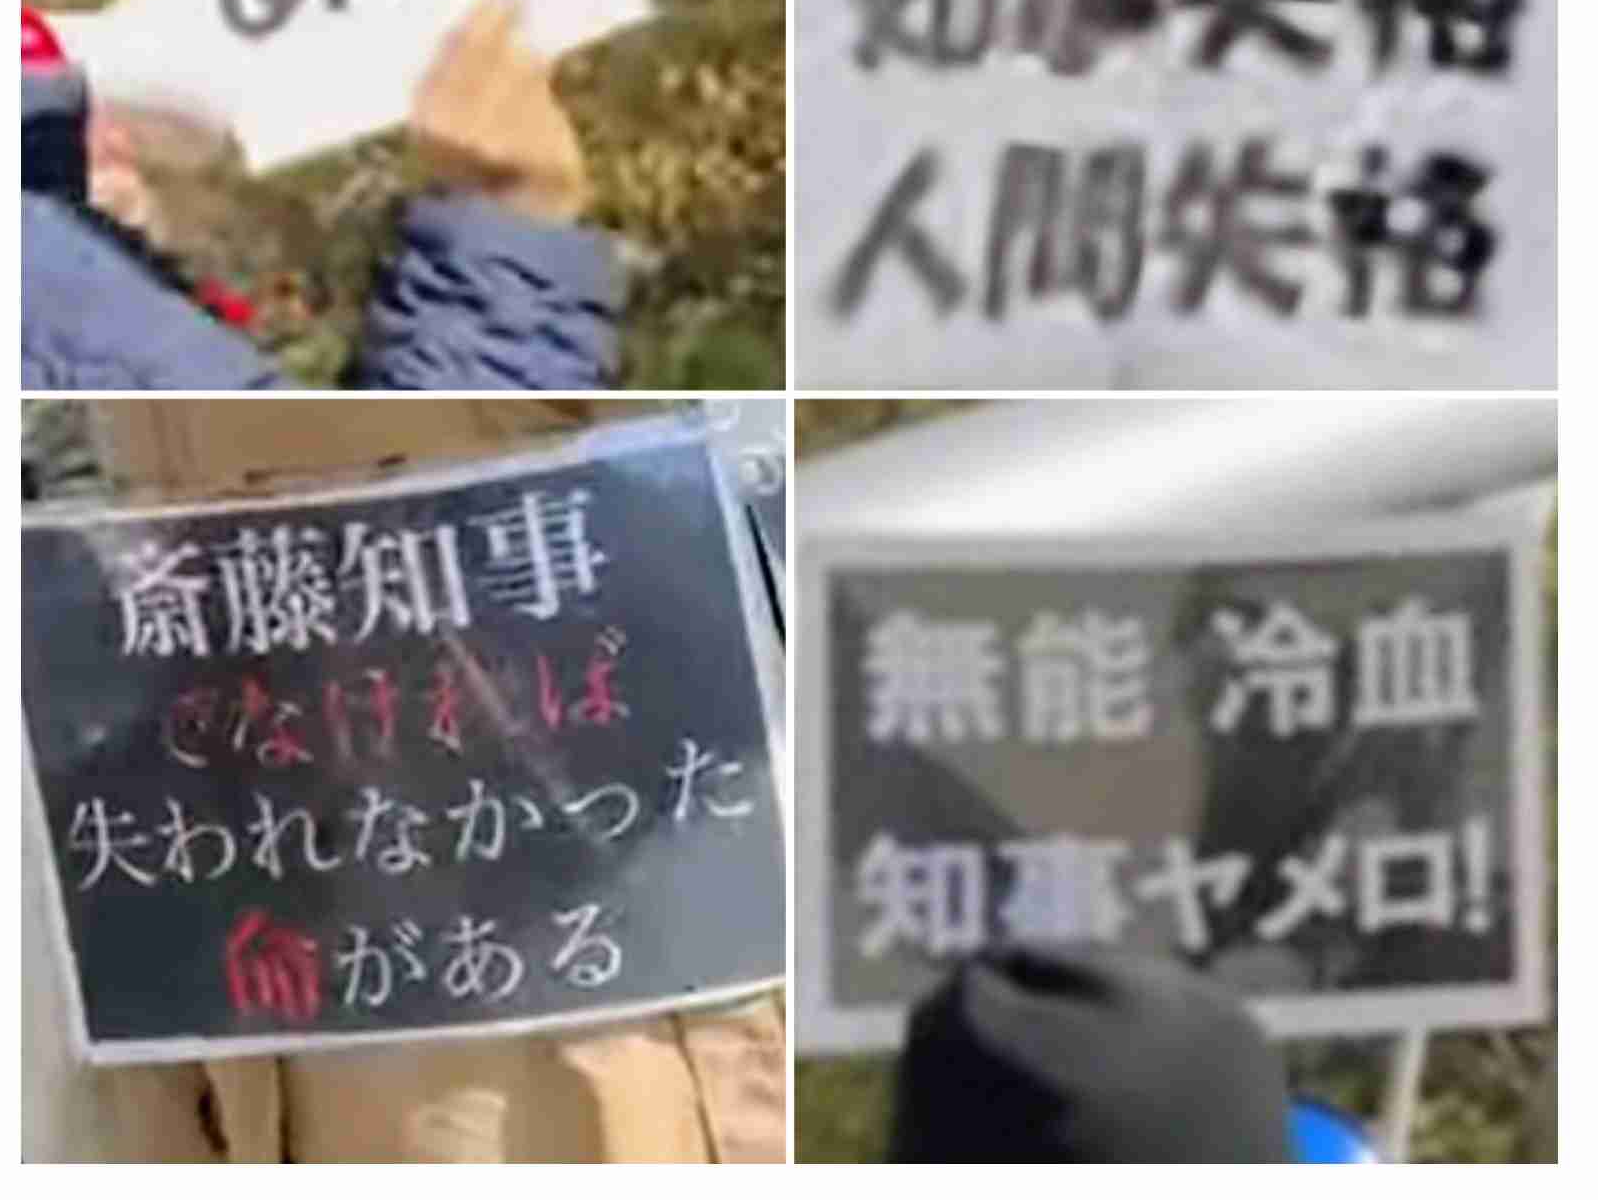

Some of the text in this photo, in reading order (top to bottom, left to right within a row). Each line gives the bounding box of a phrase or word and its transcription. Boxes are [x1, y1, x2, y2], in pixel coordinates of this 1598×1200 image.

[824, 137, 1498, 323] 人間失格
[122, 490, 607, 657] 斎藤知事
[864, 599, 1478, 744] 無能 冷血
[68, 737, 754, 893] 失われなかった
[859, 817, 1492, 960] 知事ヤメロ!
